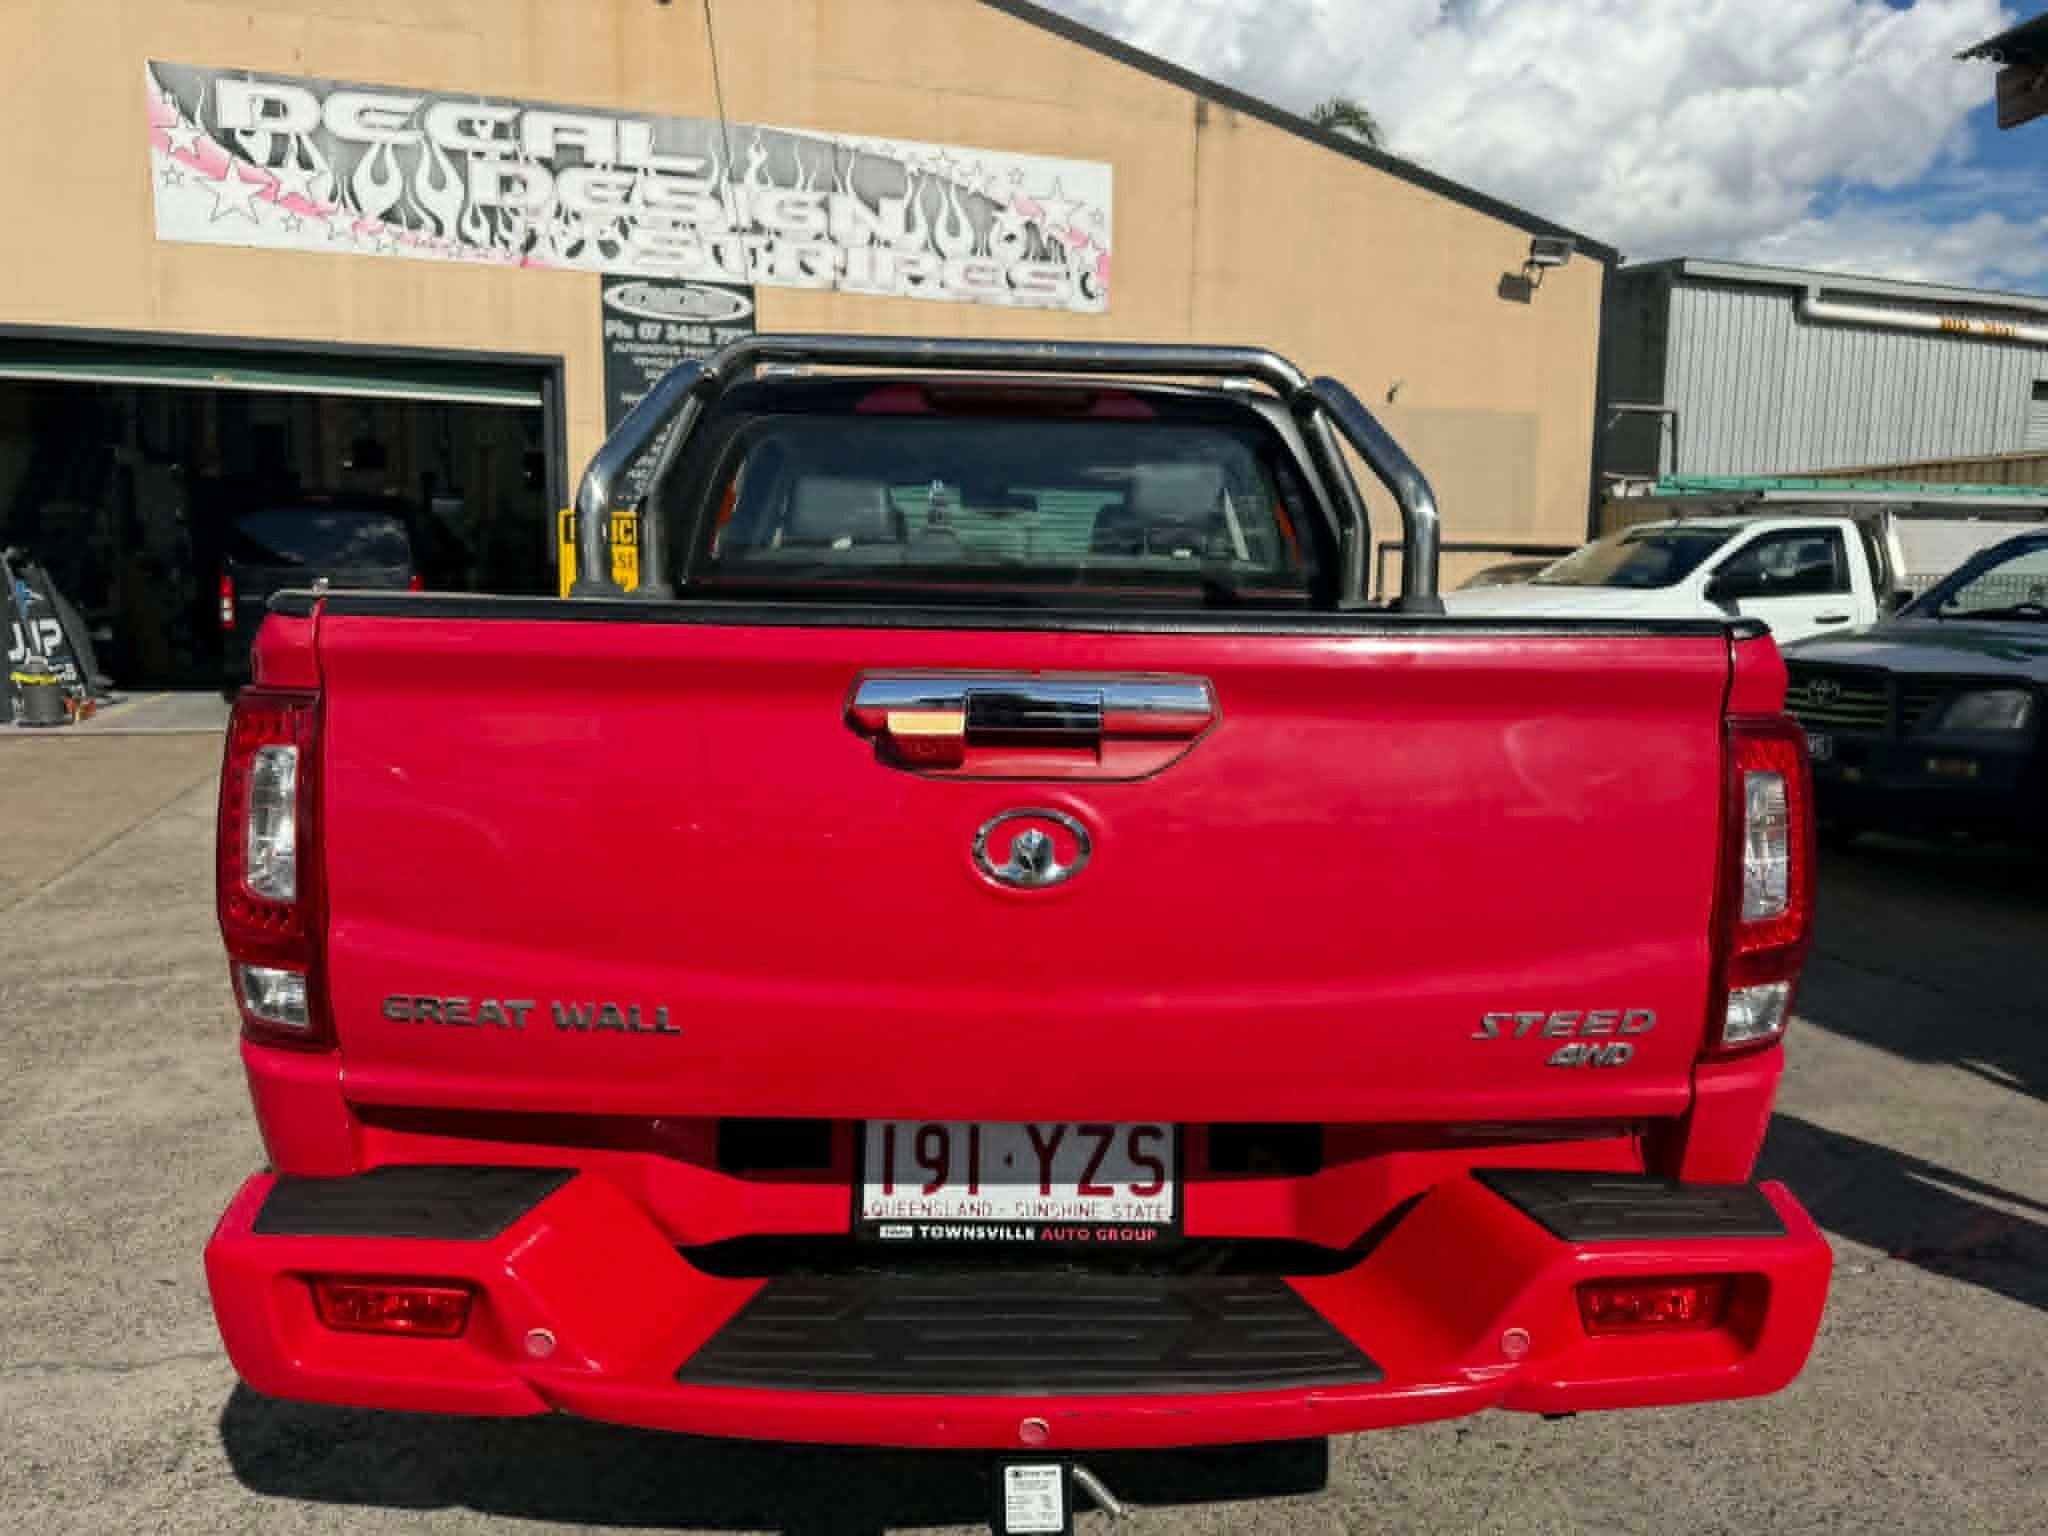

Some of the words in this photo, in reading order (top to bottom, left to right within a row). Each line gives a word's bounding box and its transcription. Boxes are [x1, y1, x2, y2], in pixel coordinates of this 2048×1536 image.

[214, 78, 708, 178] DECAL
[470, 153, 905, 249] DESIGN
[383, 994, 535, 1029] GREAT
[550, 1000, 685, 1035] WALL
[1469, 1008, 1656, 1041] STEED
[1545, 1041, 1635, 1068] 4WD
[865, 1201, 993, 1219] QUEENSLAND
[1013, 1202, 1104, 1219] SUNSHINE
[1110, 1204, 1167, 1220] STATE
[919, 1225, 1035, 1241] TOWNSVILLE
[1040, 1227, 1090, 1241] AUTO
[1095, 1228, 1157, 1242] GROUP
